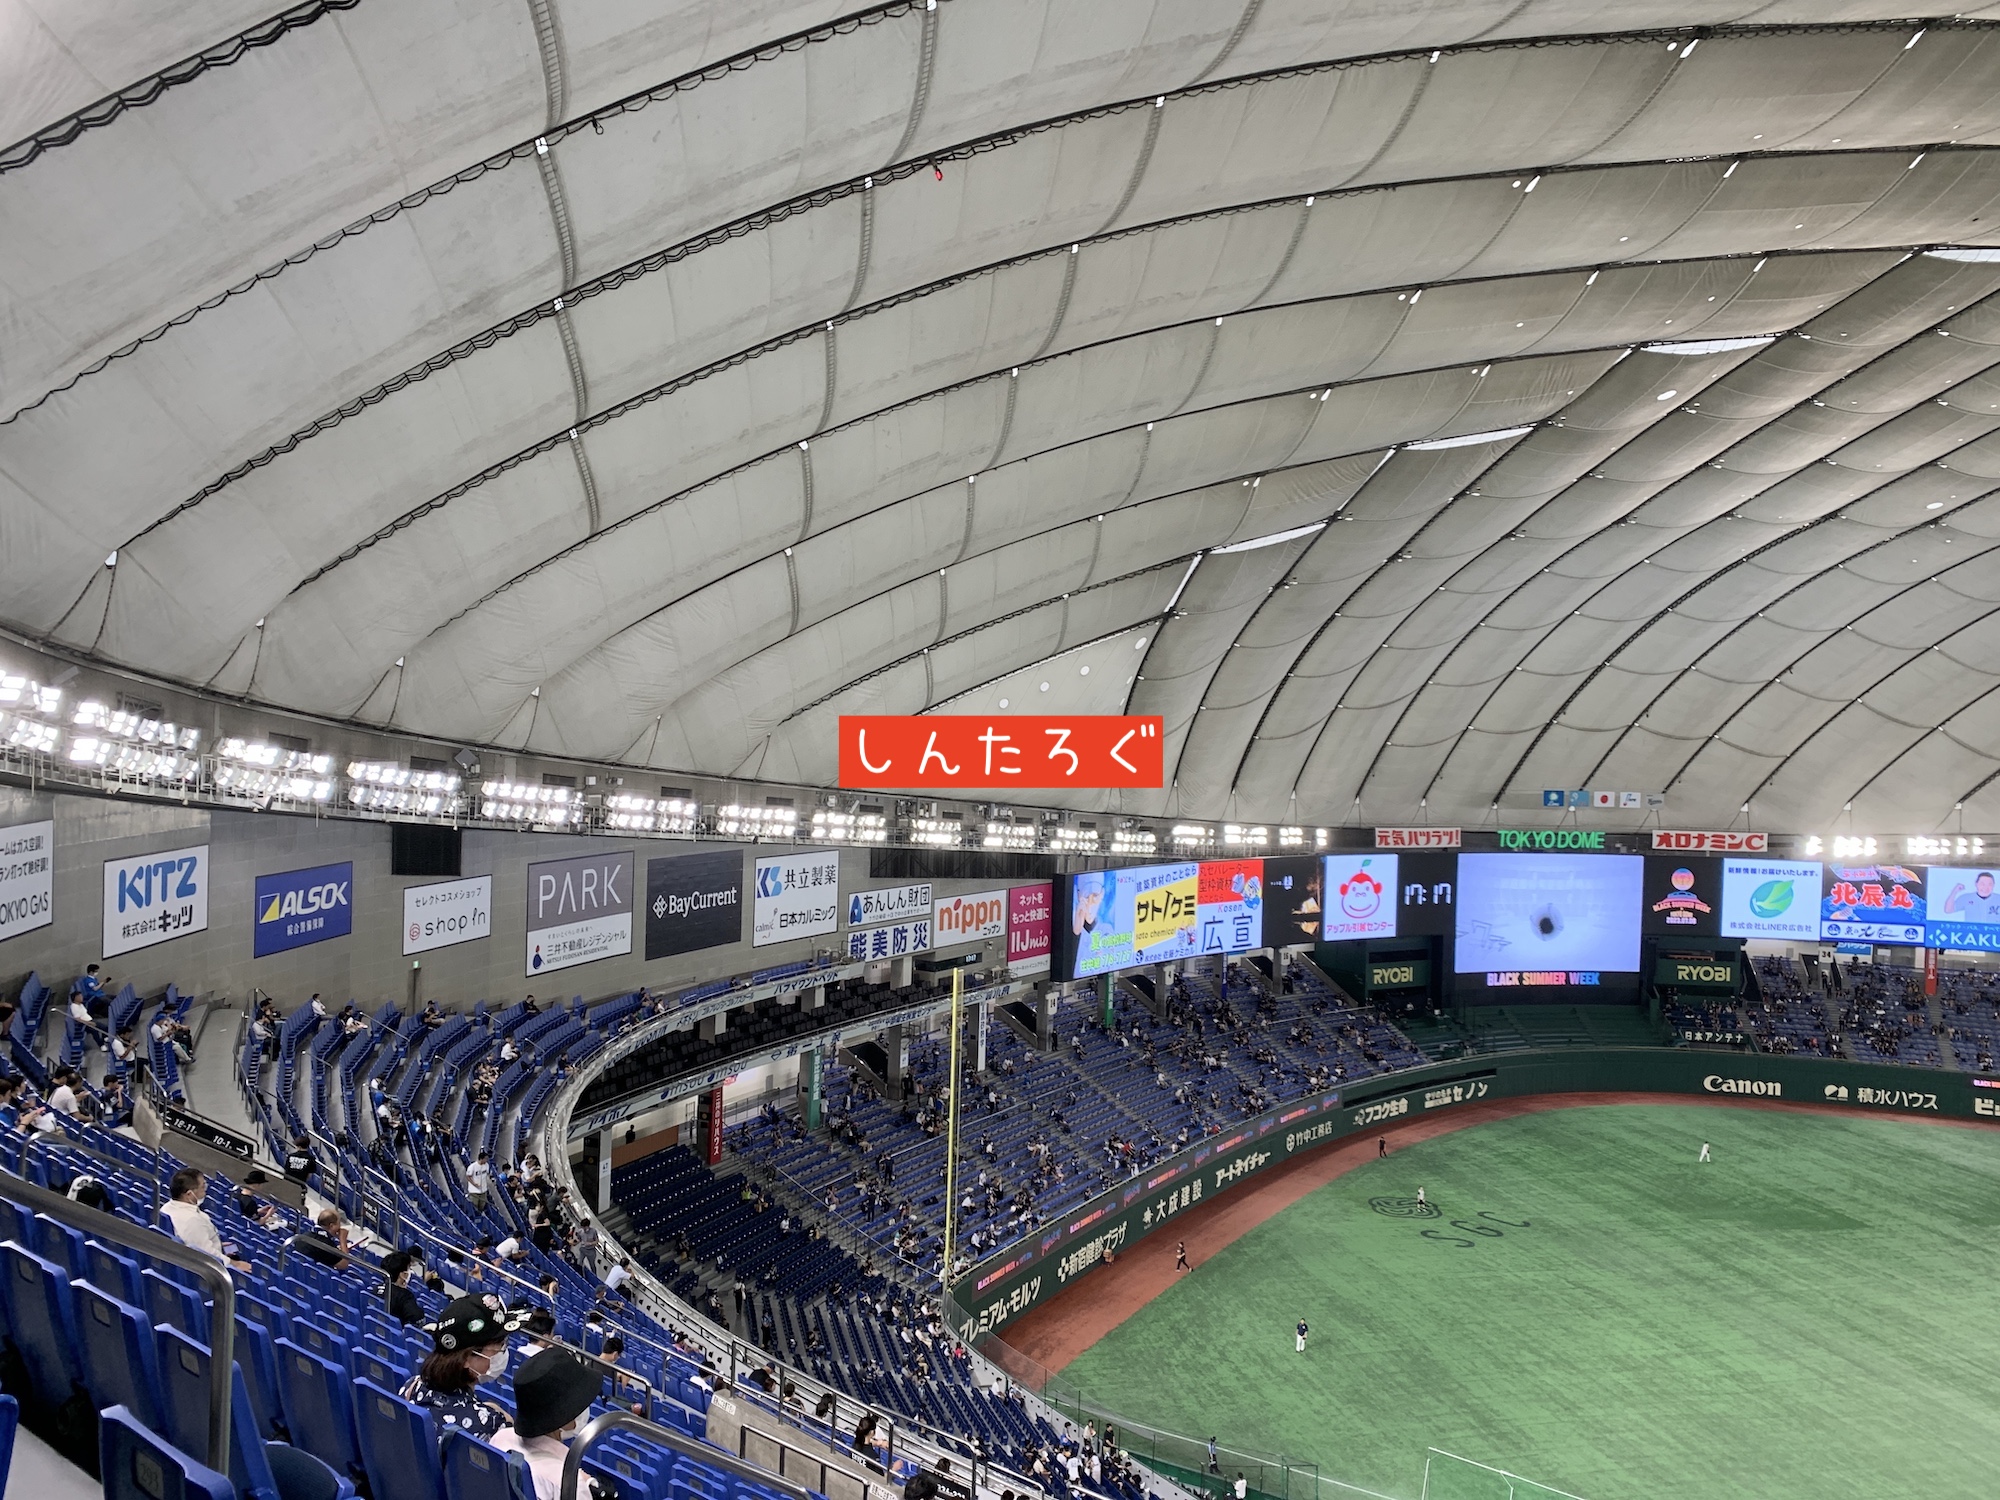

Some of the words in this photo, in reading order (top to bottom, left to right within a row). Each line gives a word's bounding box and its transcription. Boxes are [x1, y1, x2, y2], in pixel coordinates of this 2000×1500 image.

[1377, 830, 1460, 847] 元気ハツラツ!
[1498, 830, 1556, 849] TOKYO
[1556, 831, 1605, 849] DOME
[1656, 832, 1764, 850] オロナミンC
[784, 864, 836, 891] 共立製薬
[1136, 865, 1197, 893] 建築資材のことなら
[1728, 866, 1818, 877] 新鮮情報!お届けいたします。
[118, 856, 197, 913] KITZ
[538, 864, 622, 918] PARK
[1831, 882, 1913, 908] 北辰丸
[30, 891, 48, 915] GAS
[280, 881, 348, 919] ALSOK
[415, 886, 482, 908] セレクトコスメショップ
[668, 887, 737, 918] BayCurrent
[863, 886, 930, 914] あんしん財団
[1019, 892, 1044, 906] ネットを
[1218, 904, 1242, 913] Kosen
[425, 915, 468, 936] shop
[780, 905, 836, 929] 日本カルミック
[939, 898, 1001, 934] nippn
[1326, 922, 1394, 934] アップル引越センター
[1730, 922, 1812, 932] 株式会社LINER広告社
[850, 922, 928, 960] 能美防災
[983, 924, 1001, 936] ニップン
[1202, 913, 1253, 952] 広宣
[546, 930, 627, 957] 三井不動産レジデンシャル
[1373, 967, 1414, 984] RYOBI
[1487, 972, 1520, 986] BLACK
[1523, 972, 1566, 986] SUMMER
[1569, 973, 1600, 986] WEEK
[1677, 965, 1730, 982] RYOBI
[1685, 1031, 1744, 1043] 日本アンテナ
[1452, 1082, 1489, 1102] セノン
[1703, 1075, 1781, 1096] Canon
[1857, 1087, 1938, 1110] 積水ハウス
[1365, 1098, 1409, 1124] フコク生命
[713, 1091, 721, 1156] 三井のリハウス
[1295, 1120, 1333, 1147] 竹中工務店
[1215, 1151, 1271, 1188] アートネイチャー
[1156, 1178, 1203, 1223] 大成建設
[1068, 1220, 1128, 1277] 新宿健診プラザ
